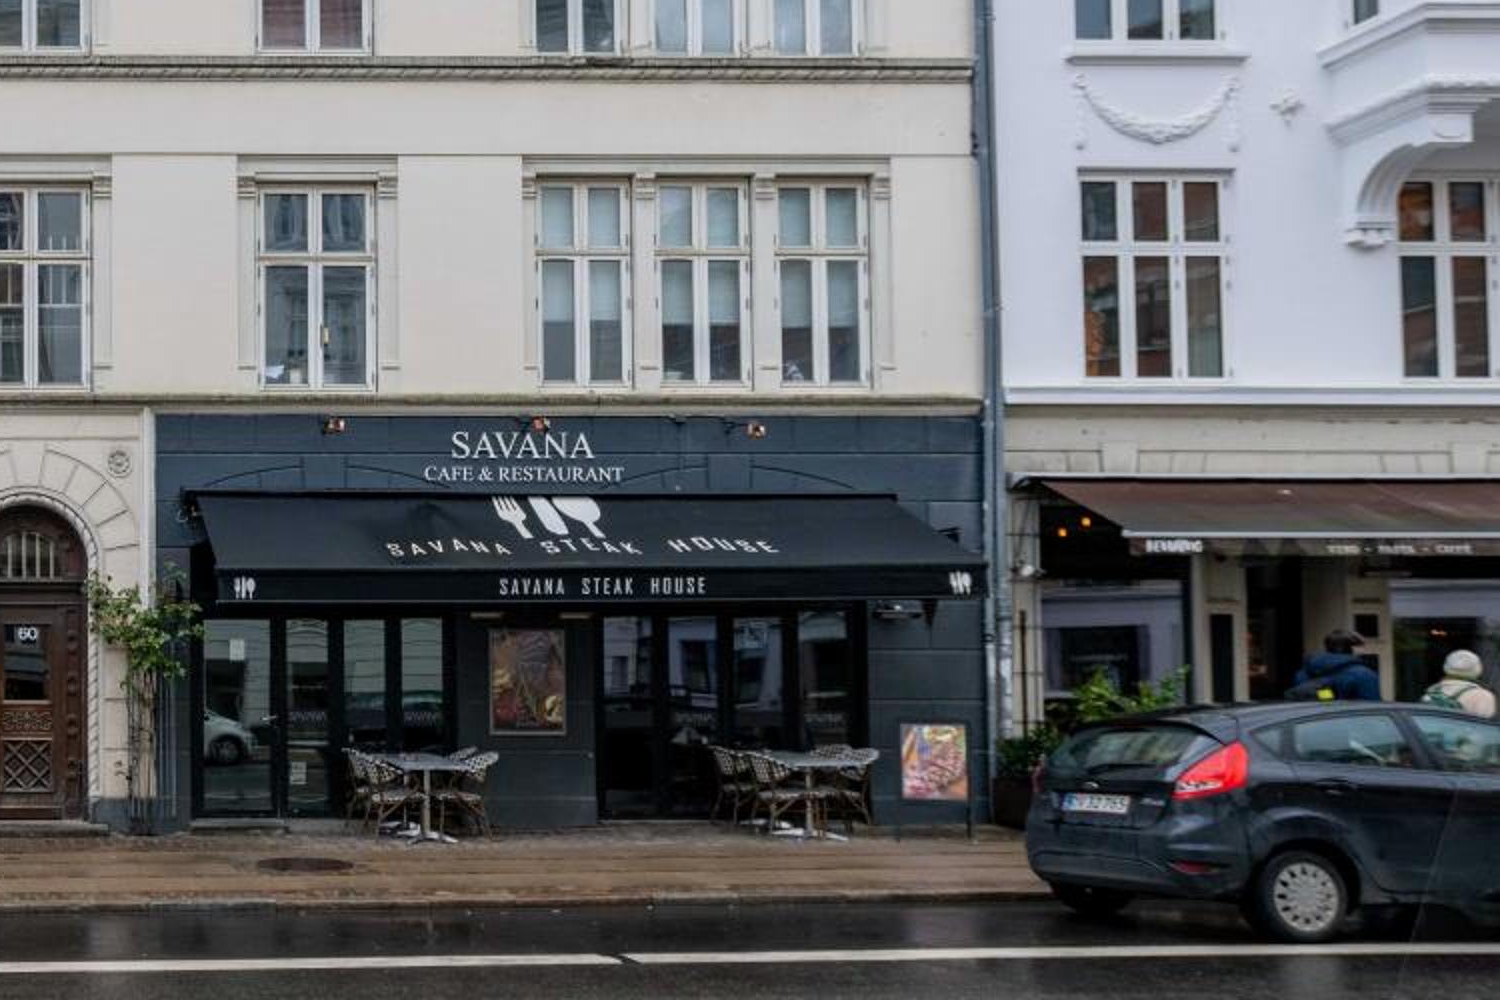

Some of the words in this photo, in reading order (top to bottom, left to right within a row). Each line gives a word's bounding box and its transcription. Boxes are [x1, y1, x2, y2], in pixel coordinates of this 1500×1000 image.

[451, 431, 596, 460] SAVANA
[424, 466, 474, 482] CAFE
[478, 467, 494, 481] &
[499, 466, 626, 482] RESTAURANT
[386, 538, 512, 557] SAVANA
[539, 537, 644, 555] STEAK
[667, 536, 780, 553] HOUSE
[499, 577, 565, 596] SAVANA
[581, 577, 634, 596] STEAK
[651, 576, 707, 596] HOUSE
